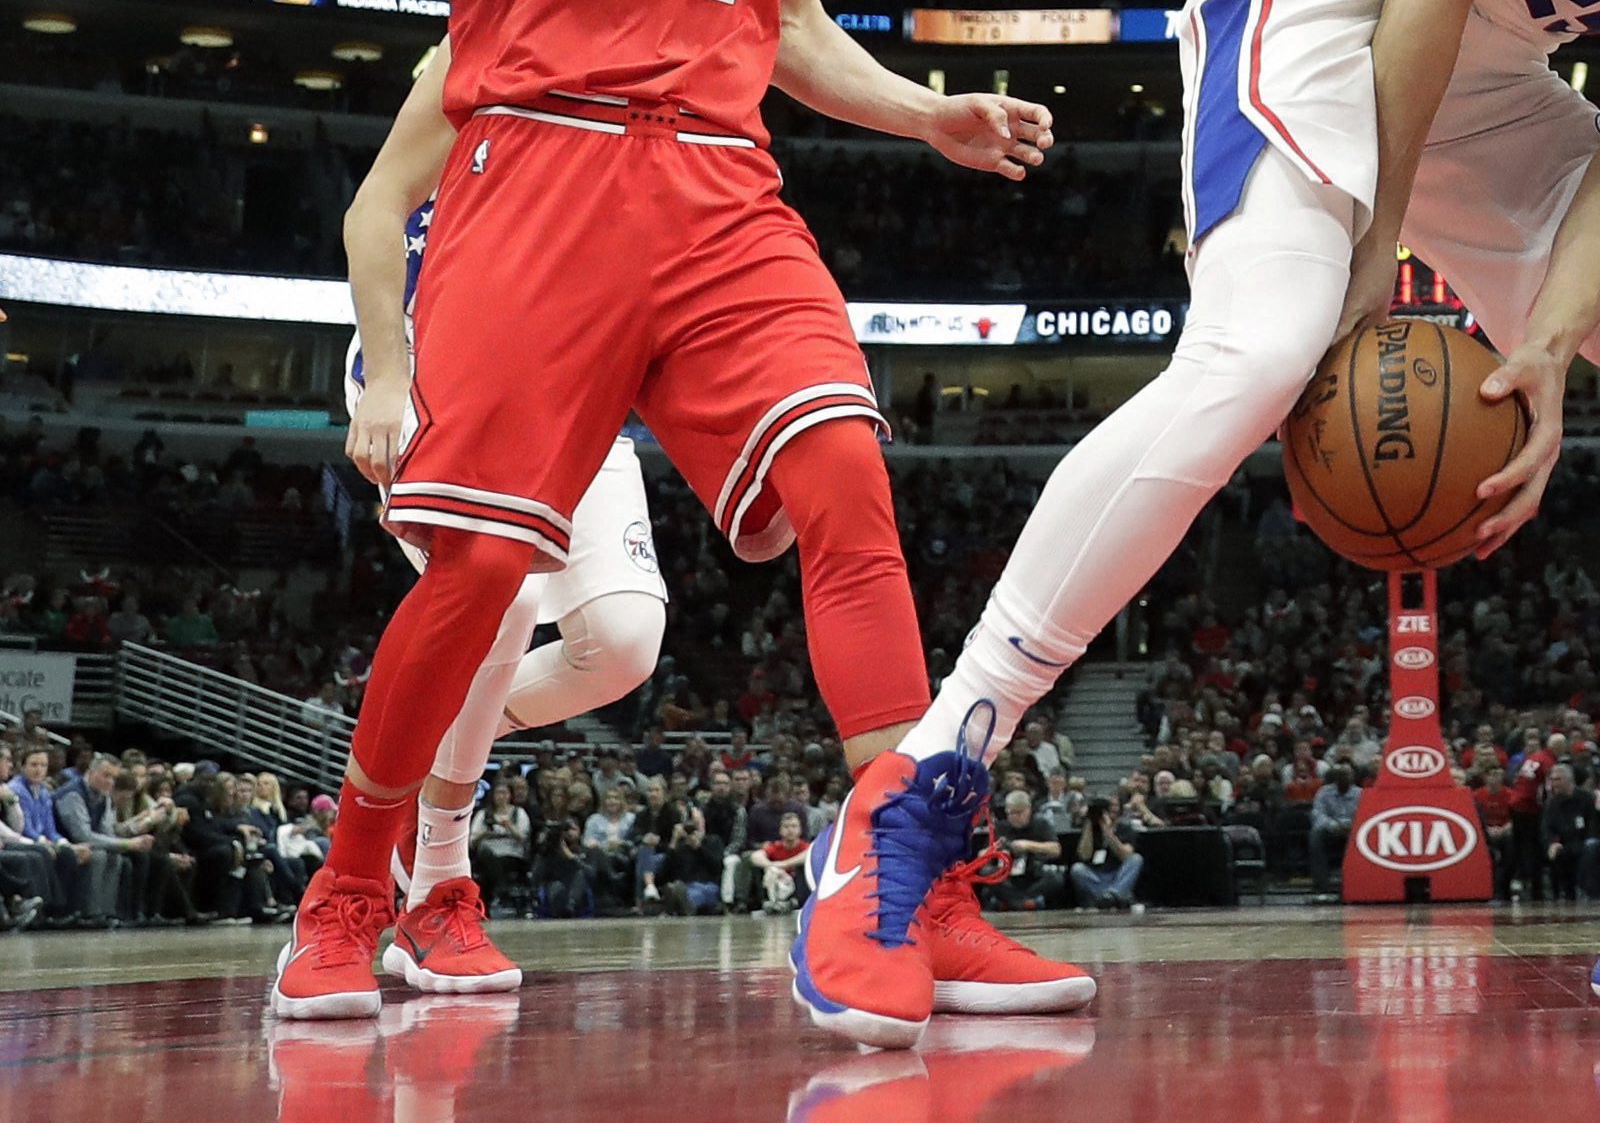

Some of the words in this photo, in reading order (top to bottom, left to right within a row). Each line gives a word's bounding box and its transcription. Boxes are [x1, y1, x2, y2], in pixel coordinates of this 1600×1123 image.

[1036, 310, 1173, 337] CHICAGO
[1396, 615, 1431, 633] ZTE
[1400, 652, 1429, 665] KIA
[1400, 701, 1430, 714] KIA
[1396, 753, 1436, 772] KIA
[1377, 820, 1458, 858] KIA
